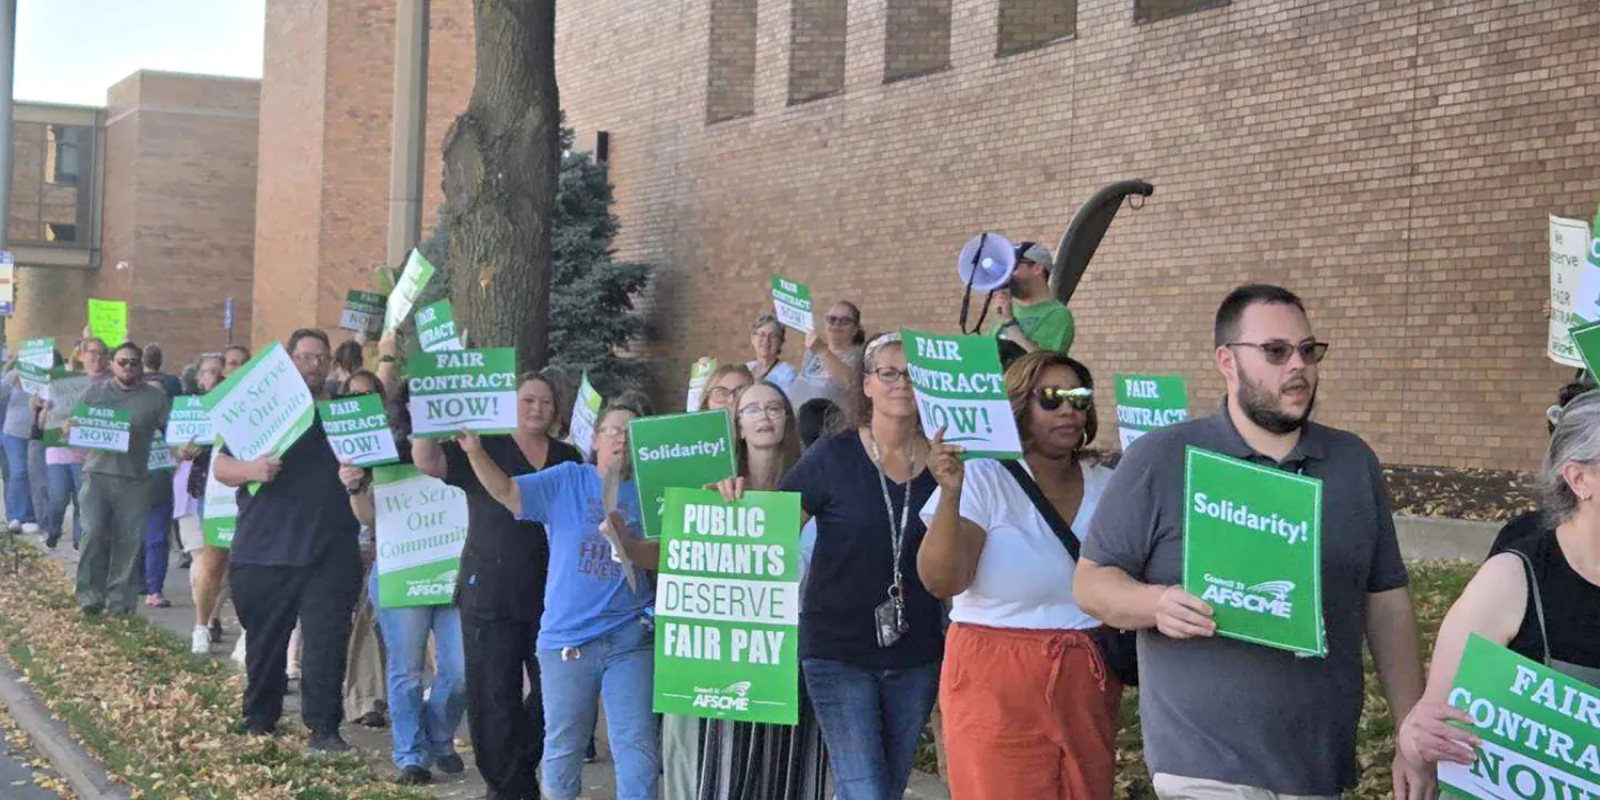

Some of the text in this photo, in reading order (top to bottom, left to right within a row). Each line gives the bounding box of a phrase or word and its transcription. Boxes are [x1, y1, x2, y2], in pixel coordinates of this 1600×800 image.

[436, 352, 485, 368] FAIR
[915, 336, 963, 361] FAIR
[409, 372, 516, 391] CONTRACT
[907, 361, 1003, 393] CONTRACT
[1125, 379, 1159, 398] FAIR
[222, 400, 249, 426] We
[247, 359, 288, 398] Serve
[87, 407, 115, 418] FAIR
[249, 391, 282, 427] Our
[329, 400, 361, 415] FAIR
[427, 397, 499, 420] NOW!
[921, 398, 993, 434] NOW!
[1117, 404, 1187, 427] CONTRACT
[79, 428, 120, 442] NOW!
[323, 413, 387, 433] CONTRACT
[333, 435, 382, 455] NOW!
[638, 437, 726, 461] Solidarity!
[385, 494, 413, 513] We
[407, 510, 447, 531] Our
[683, 503, 766, 539] PUBLIC
[1193, 492, 1309, 545] Solidarity!
[380, 525, 469, 559] Communit
[667, 538, 785, 577] SERVANTS
[665, 580, 785, 619] DESERVE
[1201, 583, 1294, 619] AFSCME
[663, 622, 786, 665] FAIR PAY
[693, 694, 750, 711] AFSCME
[1509, 664, 1600, 729] FAIR
